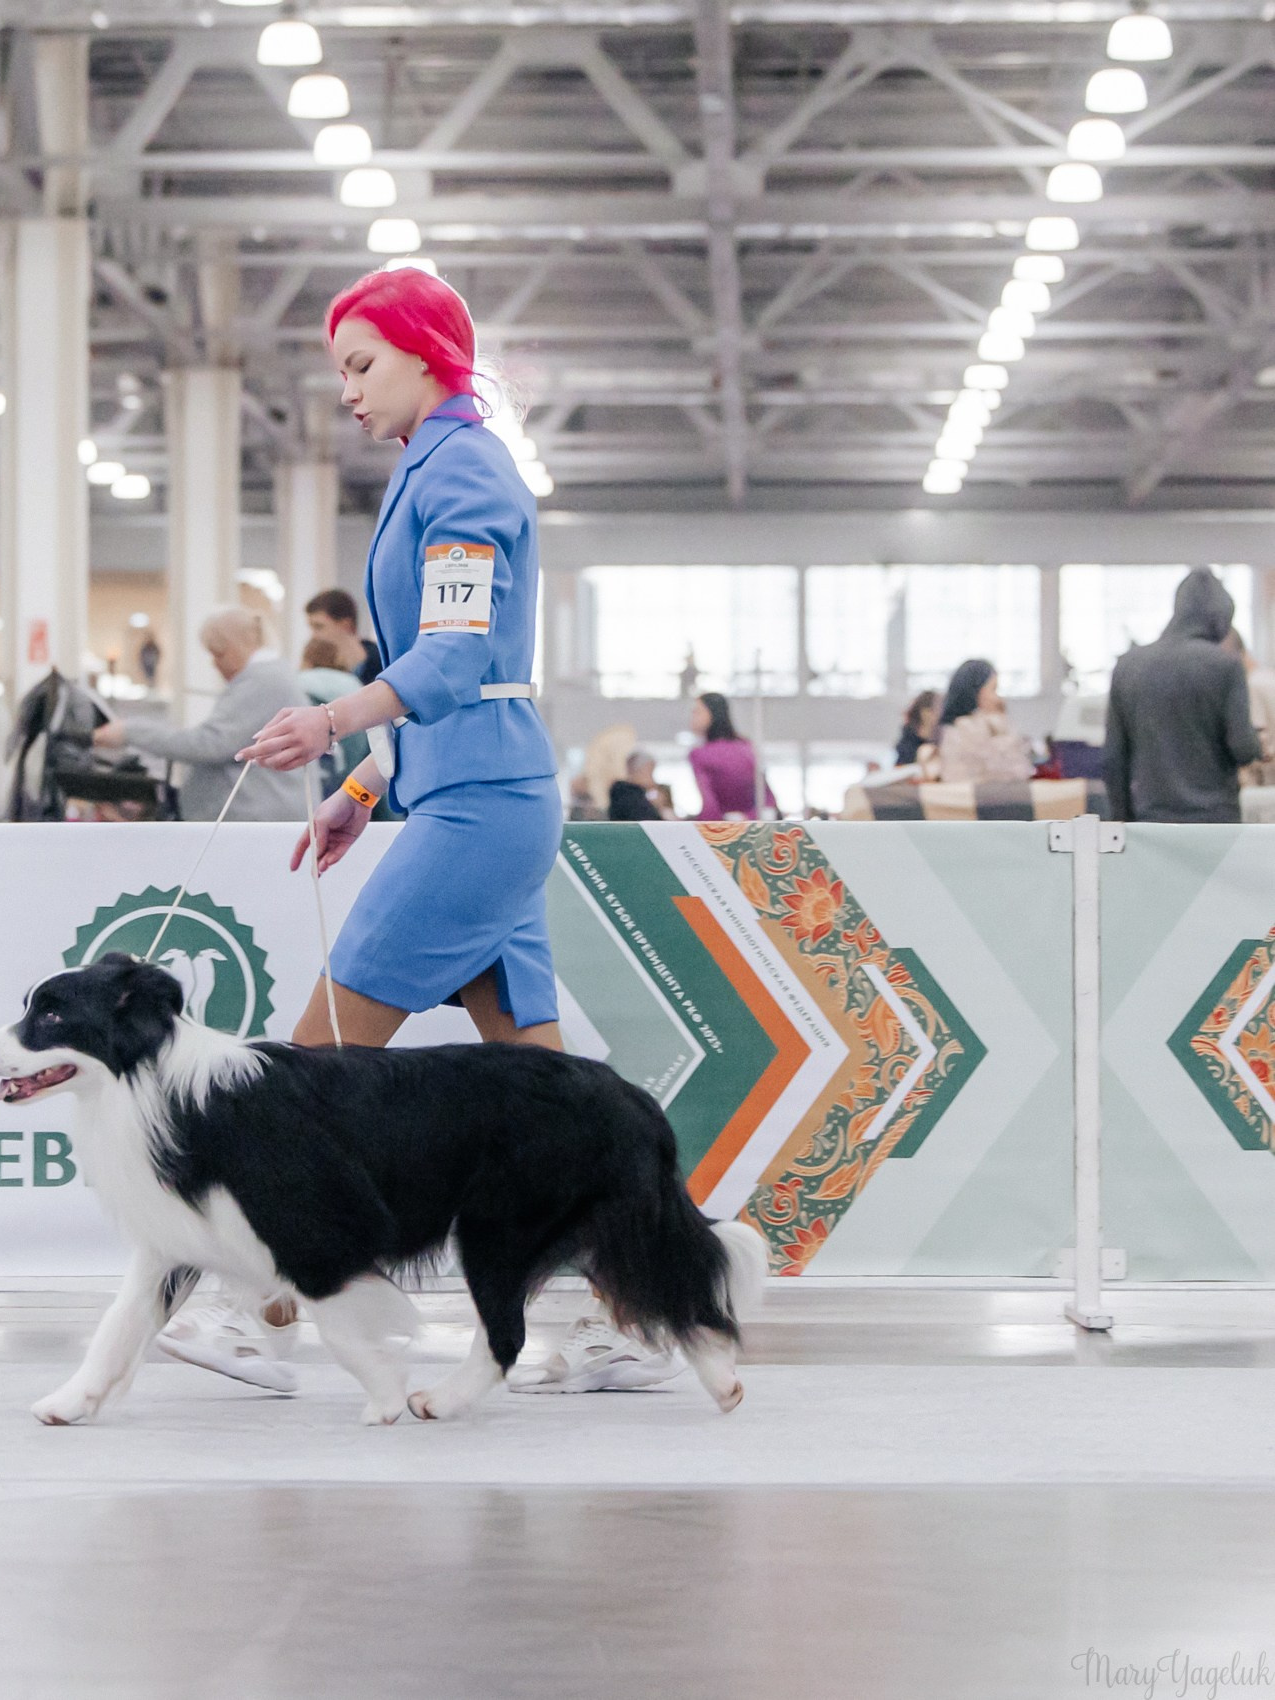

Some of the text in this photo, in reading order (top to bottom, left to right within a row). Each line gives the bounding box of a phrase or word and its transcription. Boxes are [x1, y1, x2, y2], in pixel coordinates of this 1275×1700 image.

[437, 584, 475, 604] 117
[605, 893, 637, 931] КУБОК
[632, 930, 685, 1001] ПРЕЗИДЕНТА
[681, 1000, 703, 1023] РКФ
[679, 844, 831, 1048] РОССИЙСКАЯ КИНОЛОГИЧЕСКАЯ ФЕДЕРАЦИЯ
